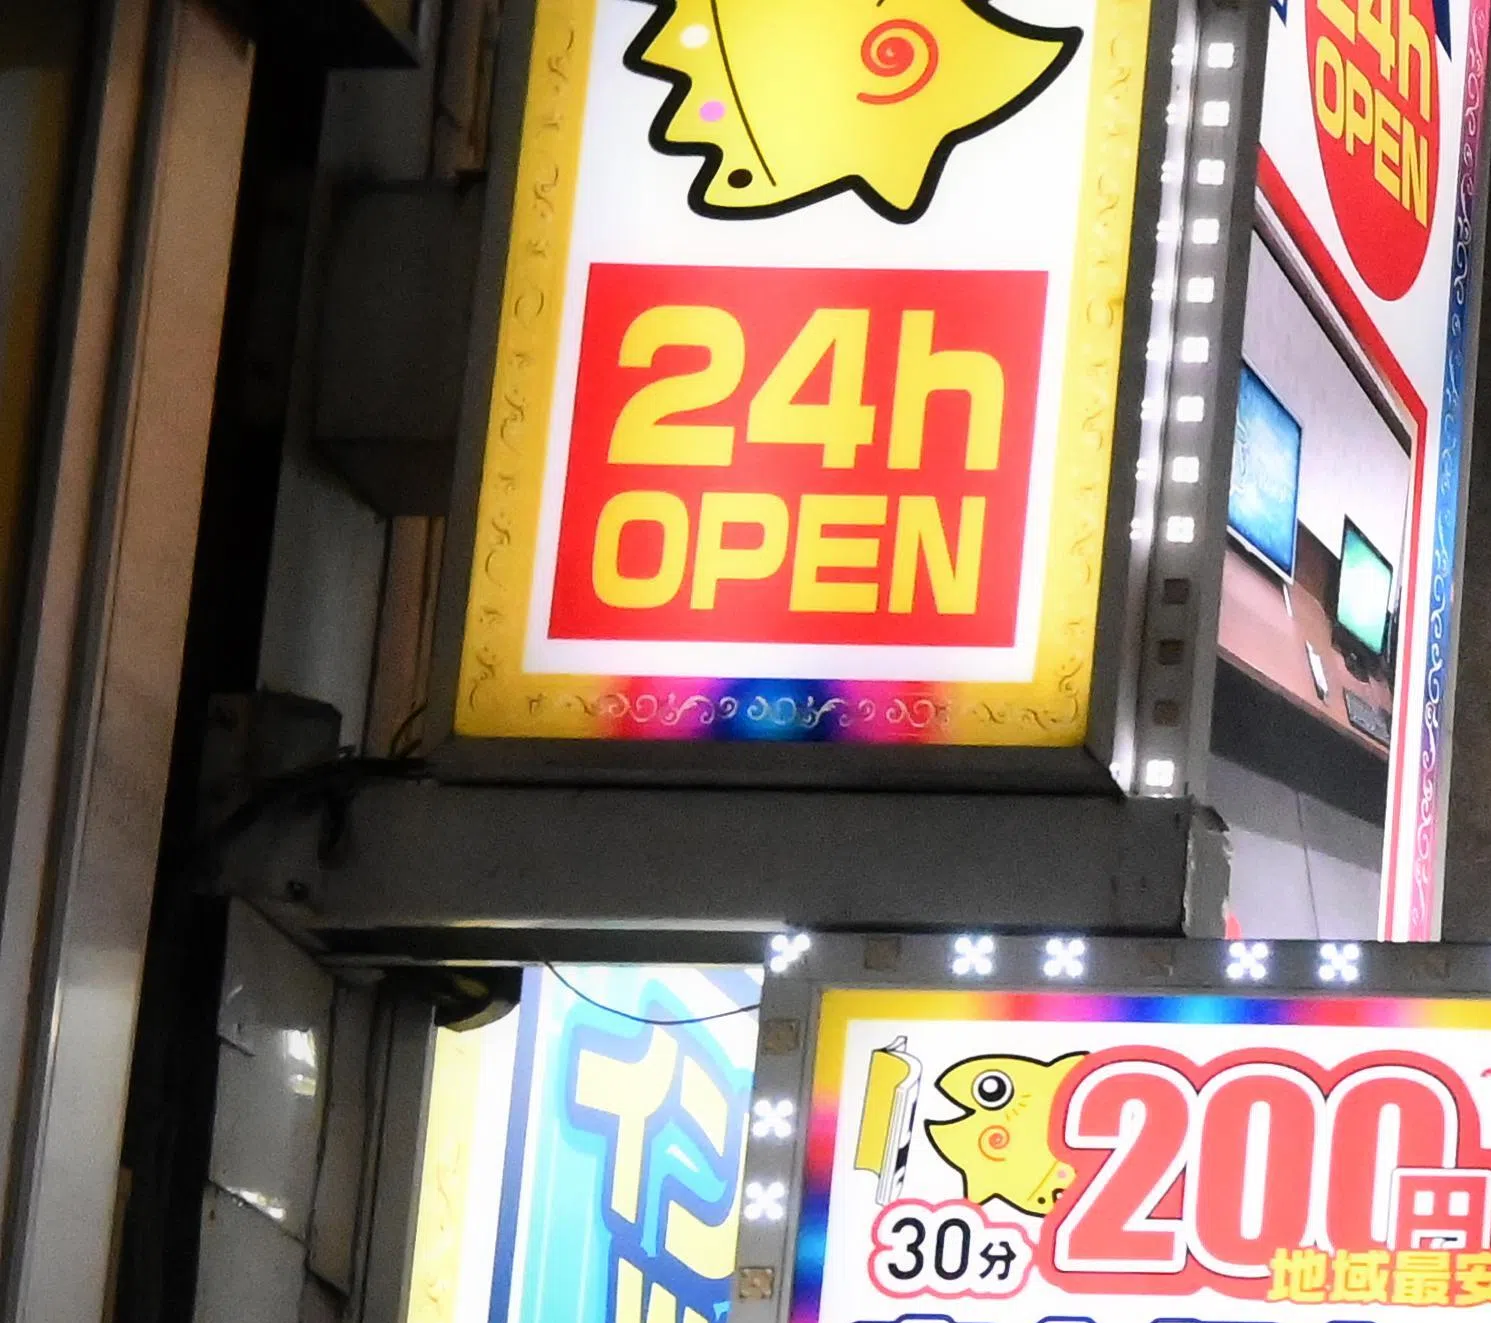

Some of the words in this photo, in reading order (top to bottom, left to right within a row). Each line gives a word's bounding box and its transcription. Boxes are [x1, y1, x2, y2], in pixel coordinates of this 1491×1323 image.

[1315, 35, 1428, 229] OPEN
[606, 304, 1006, 471] 24h
[591, 490, 987, 616] OPEN
[886, 1215, 1019, 1283] 30分
